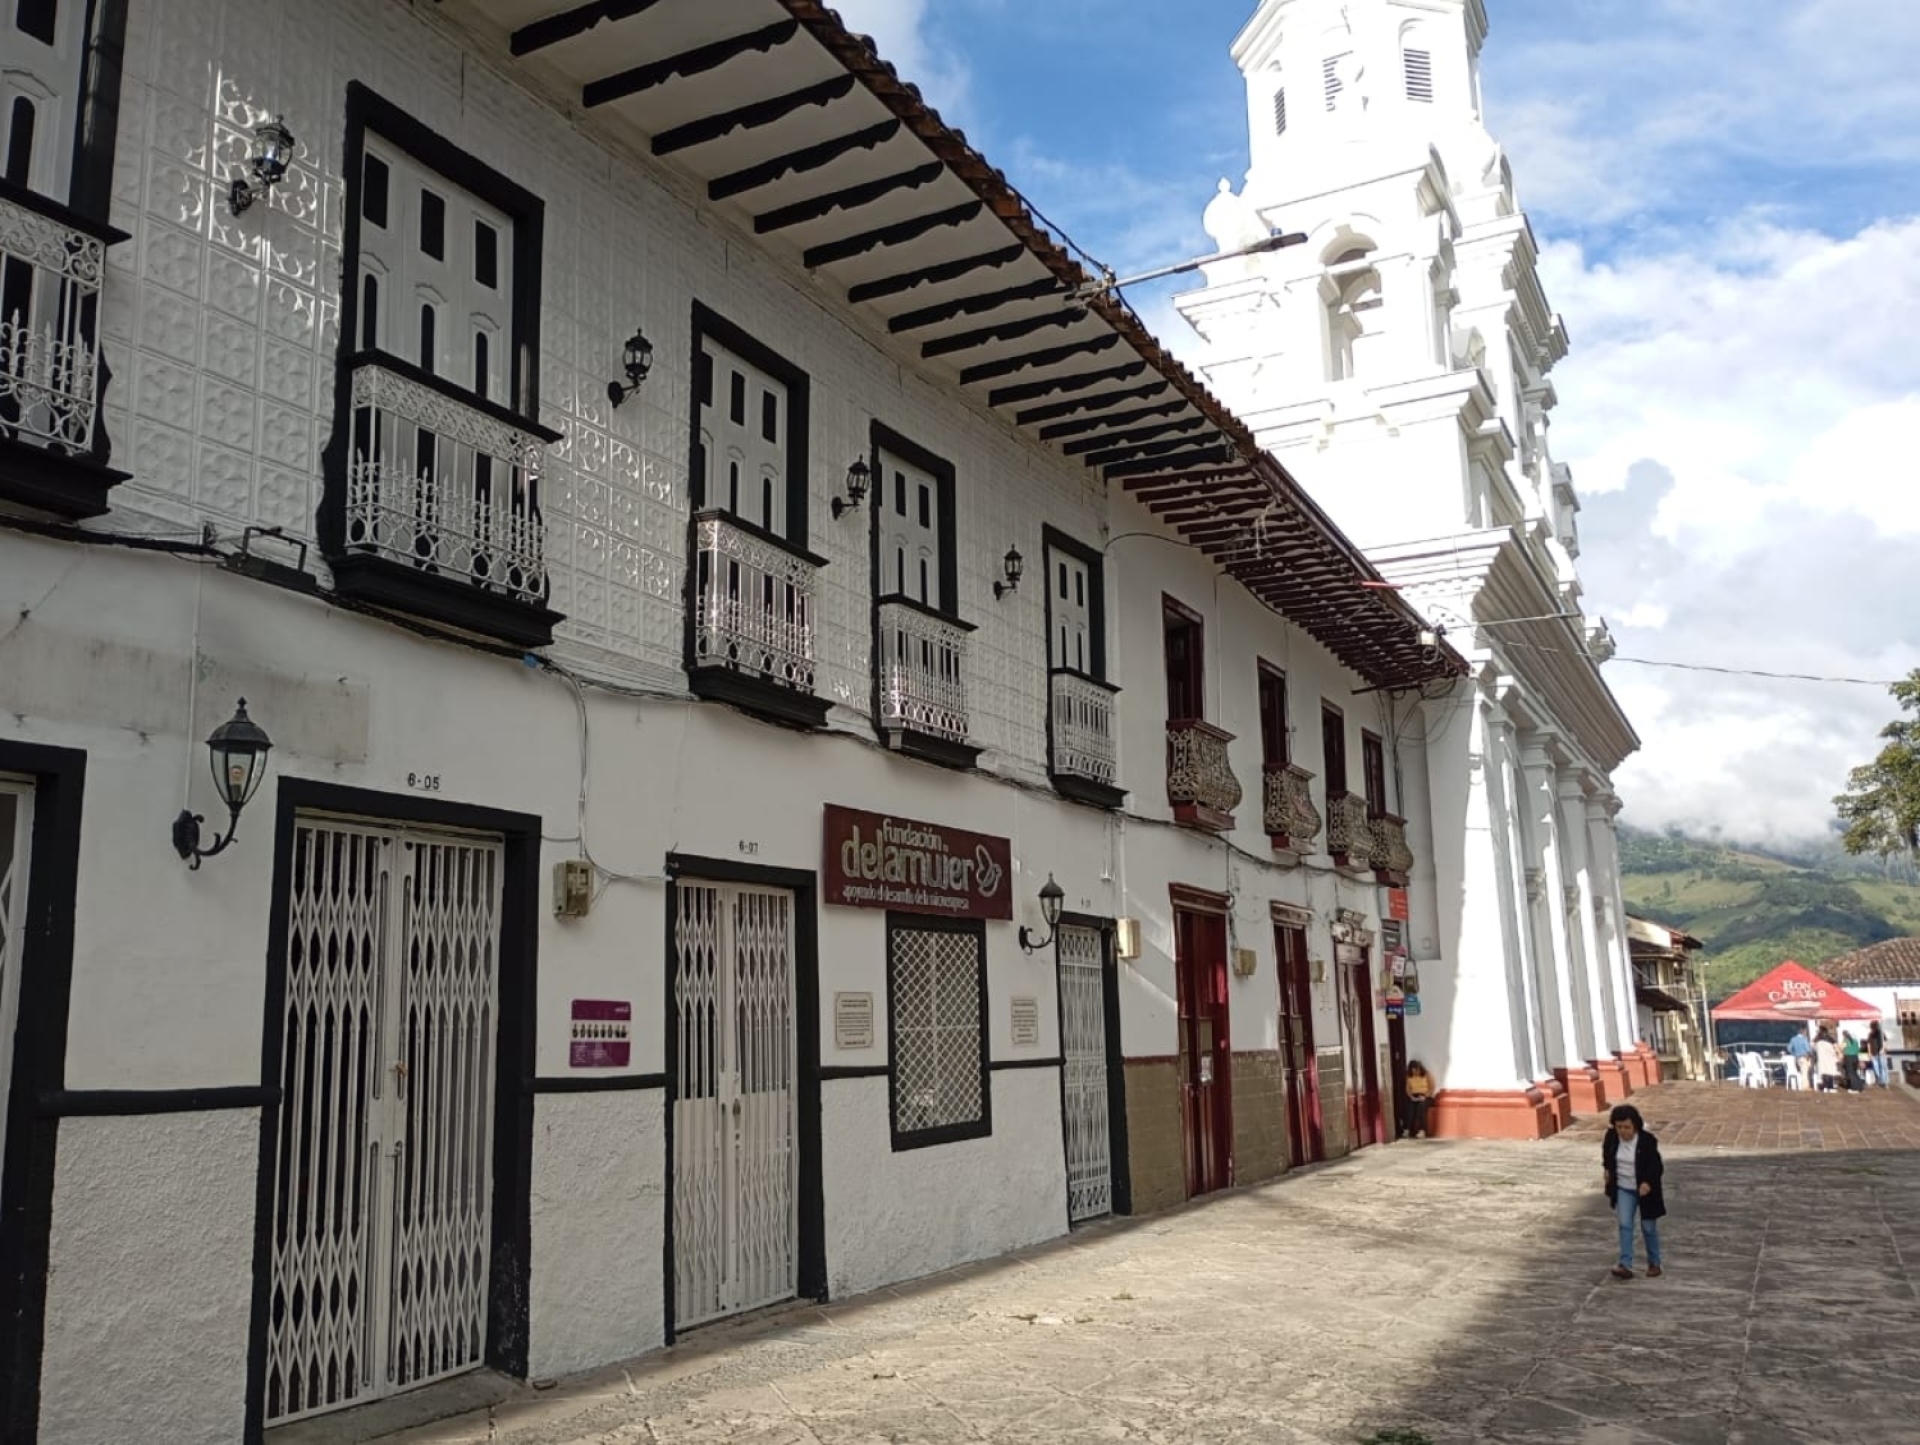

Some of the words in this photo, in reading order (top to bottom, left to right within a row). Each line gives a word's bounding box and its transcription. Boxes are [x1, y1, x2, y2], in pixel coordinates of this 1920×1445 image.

[407, 772, 440, 790] 6-05
[883, 818, 942, 850] fundación
[841, 825, 974, 892] delamujer
